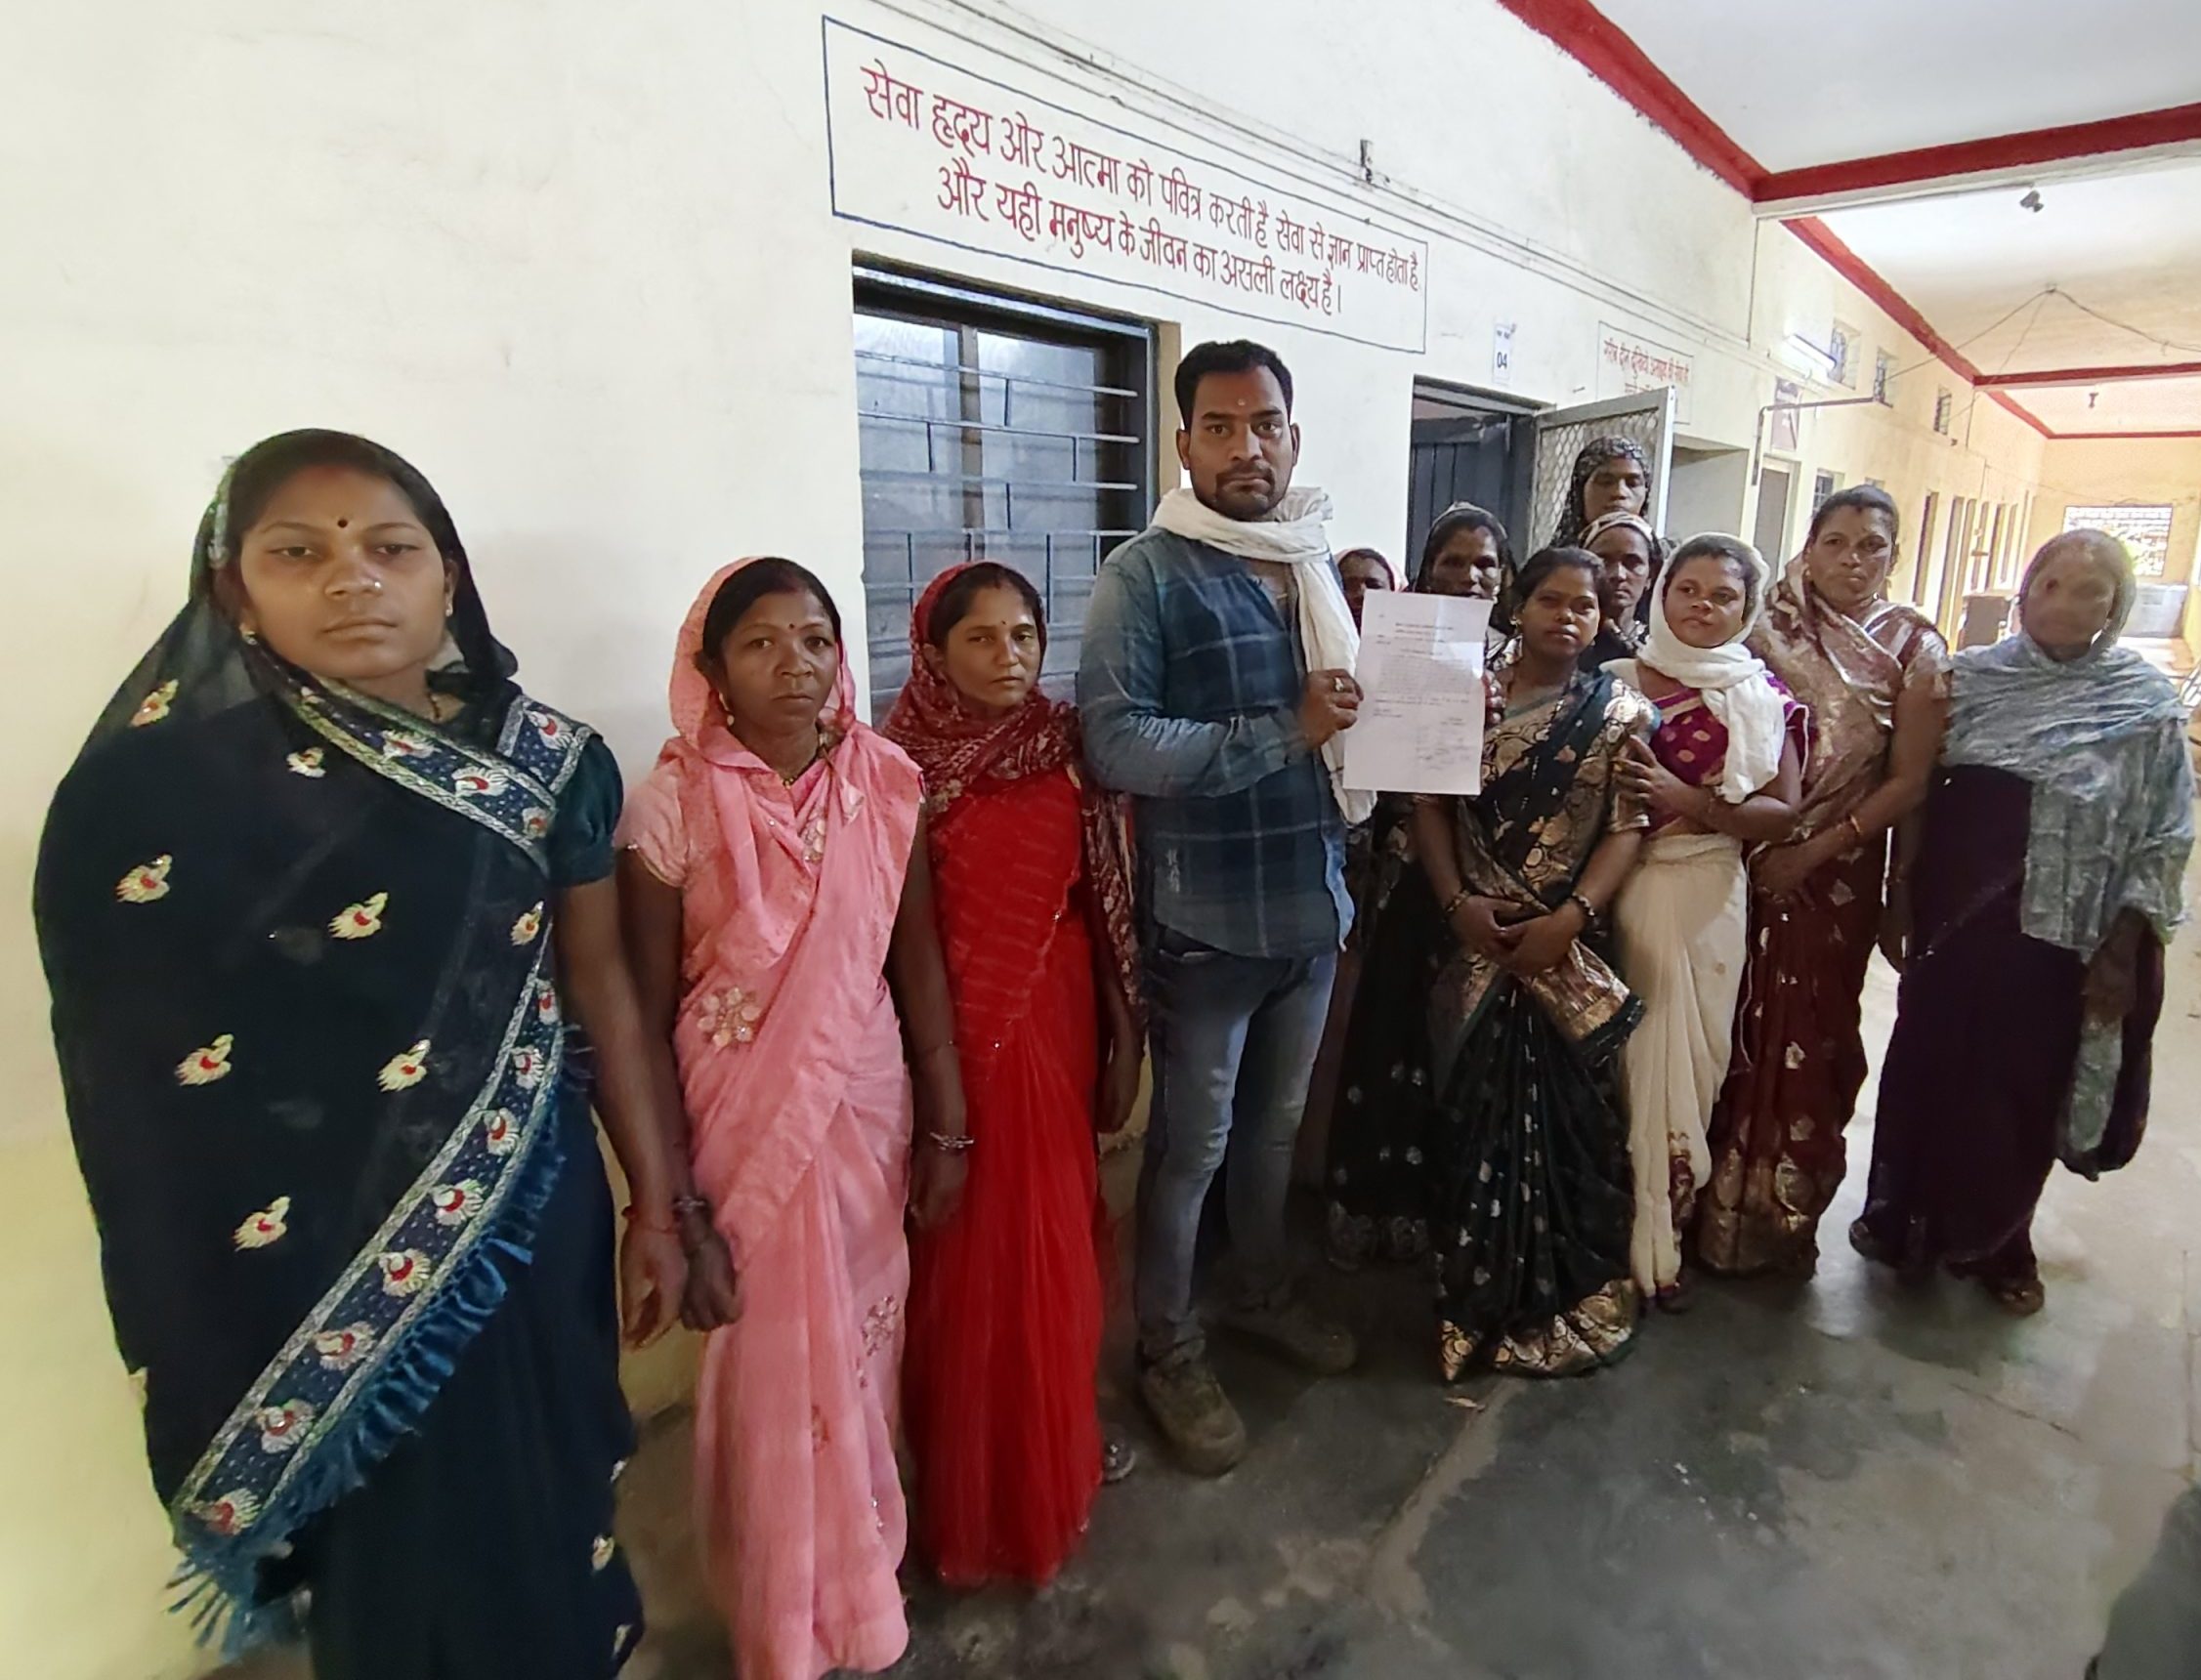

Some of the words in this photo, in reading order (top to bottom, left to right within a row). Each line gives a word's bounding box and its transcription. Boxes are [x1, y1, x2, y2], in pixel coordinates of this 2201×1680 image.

[860, 58, 924, 130] सेवा
[1052, 136, 1122, 194] आत्मा
[1126, 158, 1154, 207] को
[1159, 167, 1202, 221] पवित्र
[1209, 192, 1255, 240] करती
[1255, 199, 1269, 249] है
[1276, 209, 1305, 255] सेवा
[1308, 222, 1326, 261] से
[1328, 234, 1354, 271] ज्ञान
[1356, 243, 1386, 278] प्राप्त
[1385, 248, 1409, 284] होता
[938, 156, 990, 222] और
[995, 181, 1043, 241] यही
[1048, 200, 1116, 259] मनुष्य
[1119, 210, 1135, 256] के
[1139, 217, 1189, 273] जीवन
[1193, 242, 1218, 281] का
[1221, 250, 1276, 295] असली
[1280, 270, 1321, 310] लक्ष्य
[1497, 351, 1508, 369] 04
